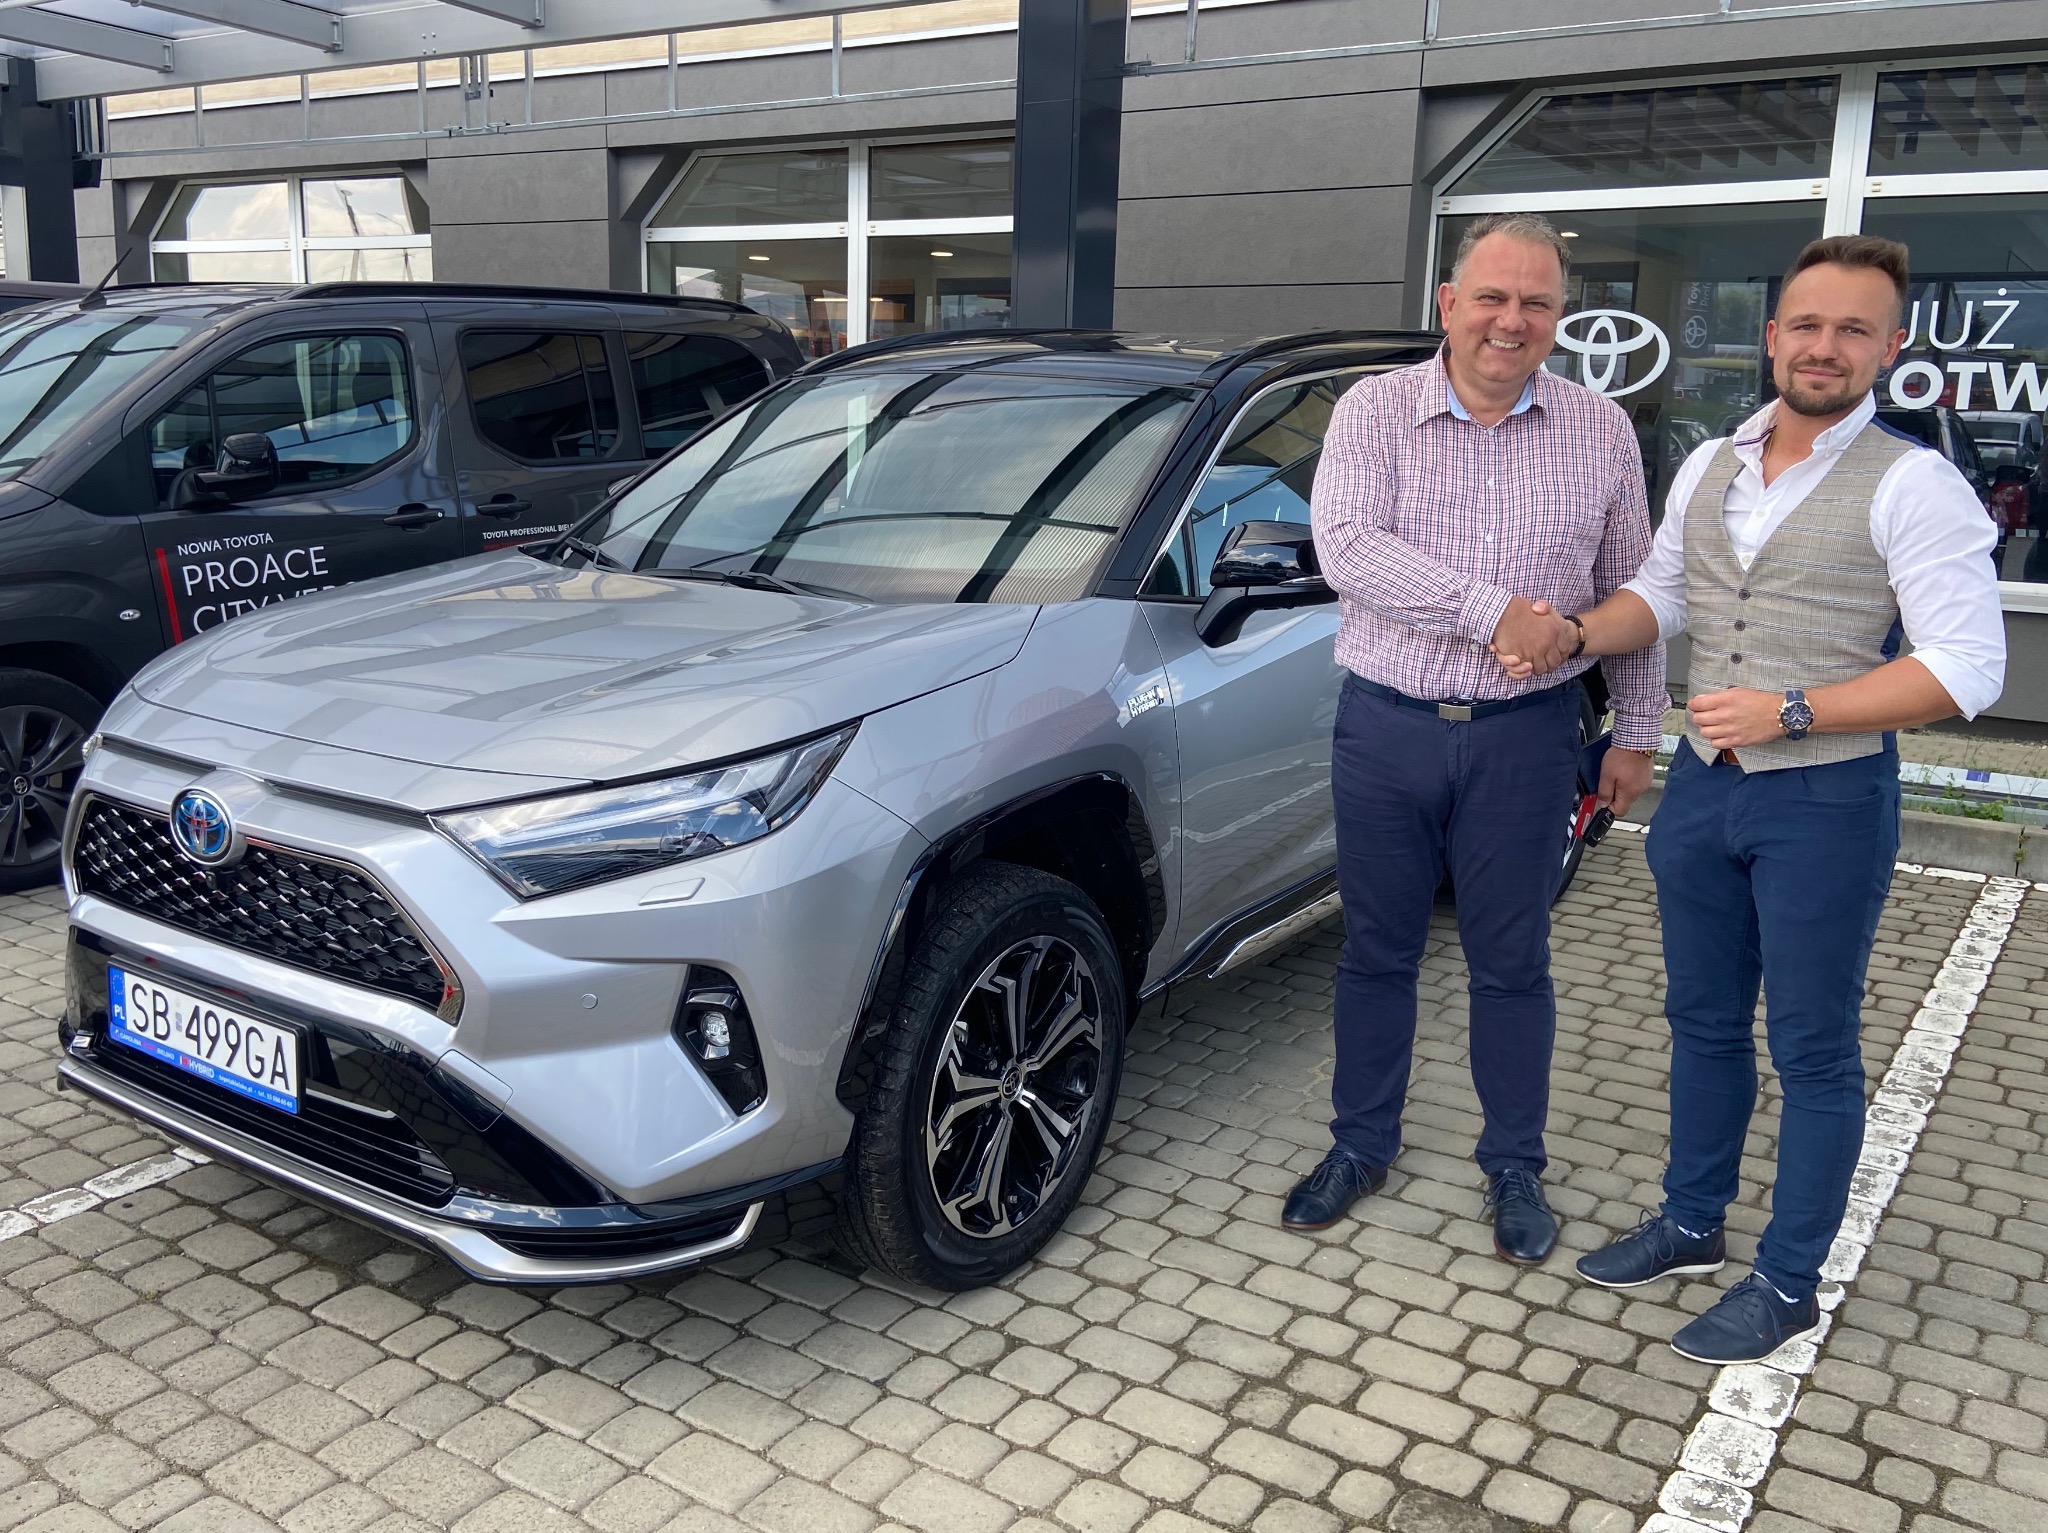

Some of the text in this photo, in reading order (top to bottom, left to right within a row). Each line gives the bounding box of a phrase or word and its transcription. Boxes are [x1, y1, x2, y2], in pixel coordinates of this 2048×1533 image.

[1900, 287, 2020, 350] JUŻ
[177, 532, 274, 556] NOWA TOYOTA
[482, 530, 509, 540] TOYOTA
[510, 525, 557, 537] PROFESSIONAL
[182, 545, 329, 597] PROACE
[114, 1004, 125, 1021] PL
[131, 983, 290, 1091] SB 499GA
[189, 1059, 215, 1079] HYBRID
